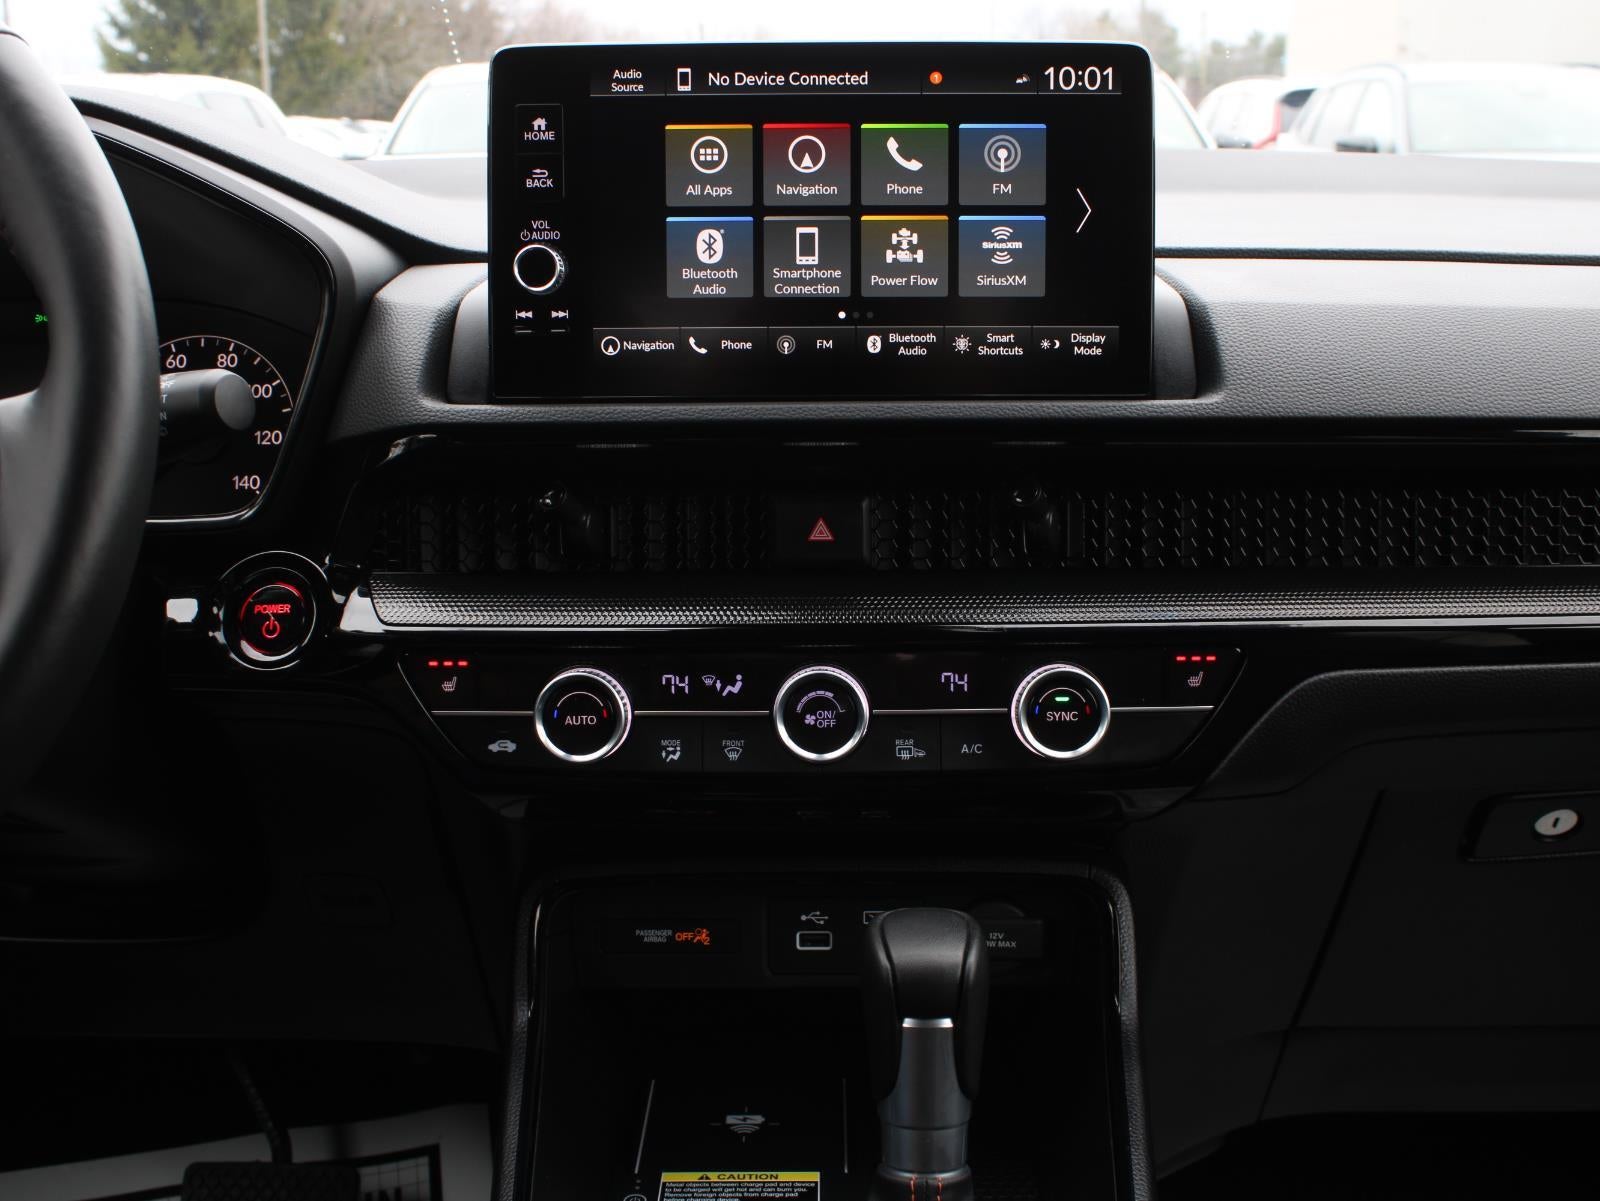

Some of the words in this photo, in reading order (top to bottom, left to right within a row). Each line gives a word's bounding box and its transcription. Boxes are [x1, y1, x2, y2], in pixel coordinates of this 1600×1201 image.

[613, 69, 642, 79] Audio
[709, 73, 729, 85] No
[735, 72, 784, 85] Device
[789, 71, 868, 85] Connected
[1045, 66, 1112, 90] 10:01
[612, 83, 643, 91] Source
[524, 132, 555, 140] HOME
[526, 179, 553, 187] BACK
[686, 185, 700, 195] All
[704, 185, 732, 197] Apps
[777, 184, 837, 196] Navigation
[887, 184, 922, 194] Phone
[993, 184, 1011, 194] FM
[532, 221, 550, 229] VOL
[532, 231, 560, 239] AUDIO
[982, 241, 1023, 249] SiriusXM
[683, 268, 737, 278] Bluetooth
[773, 267, 842, 282] Smartphone
[872, 276, 907, 285] Power
[911, 275, 938, 285] Flow
[977, 275, 1026, 285] SiriusXM
[693, 284, 726, 294] Audio
[775, 283, 839, 294] Connection
[890, 333, 936, 342] Bluetooth
[987, 333, 1014, 342] Smart
[1071, 333, 1105, 345] Display
[624, 341, 674, 351] Navigation
[722, 340, 752, 349] Phone
[817, 340, 832, 348] FM
[898, 346, 926, 355] Audio
[978, 346, 1023, 355] Shortcuts
[1074, 346, 1101, 355] Mode
[166, 354, 187, 369] 60
[217, 353, 238, 368] 80
[249, 384, 272, 398] 00
[254, 430, 283, 445] 120
[232, 475, 261, 490] 140
[254, 604, 291, 615] POWER
[662, 675, 688, 694] 74
[942, 673, 967, 692] 74
[565, 716, 596, 725] AUTO
[817, 711, 836, 720] ON/
[1047, 712, 1078, 721] SYNC
[816, 719, 836, 728] OFF
[961, 744, 982, 753] A/C
[635, 929, 673, 937] PASSENGER
[675, 932, 695, 942] OFF
[998, 940, 1017, 948] MAX
